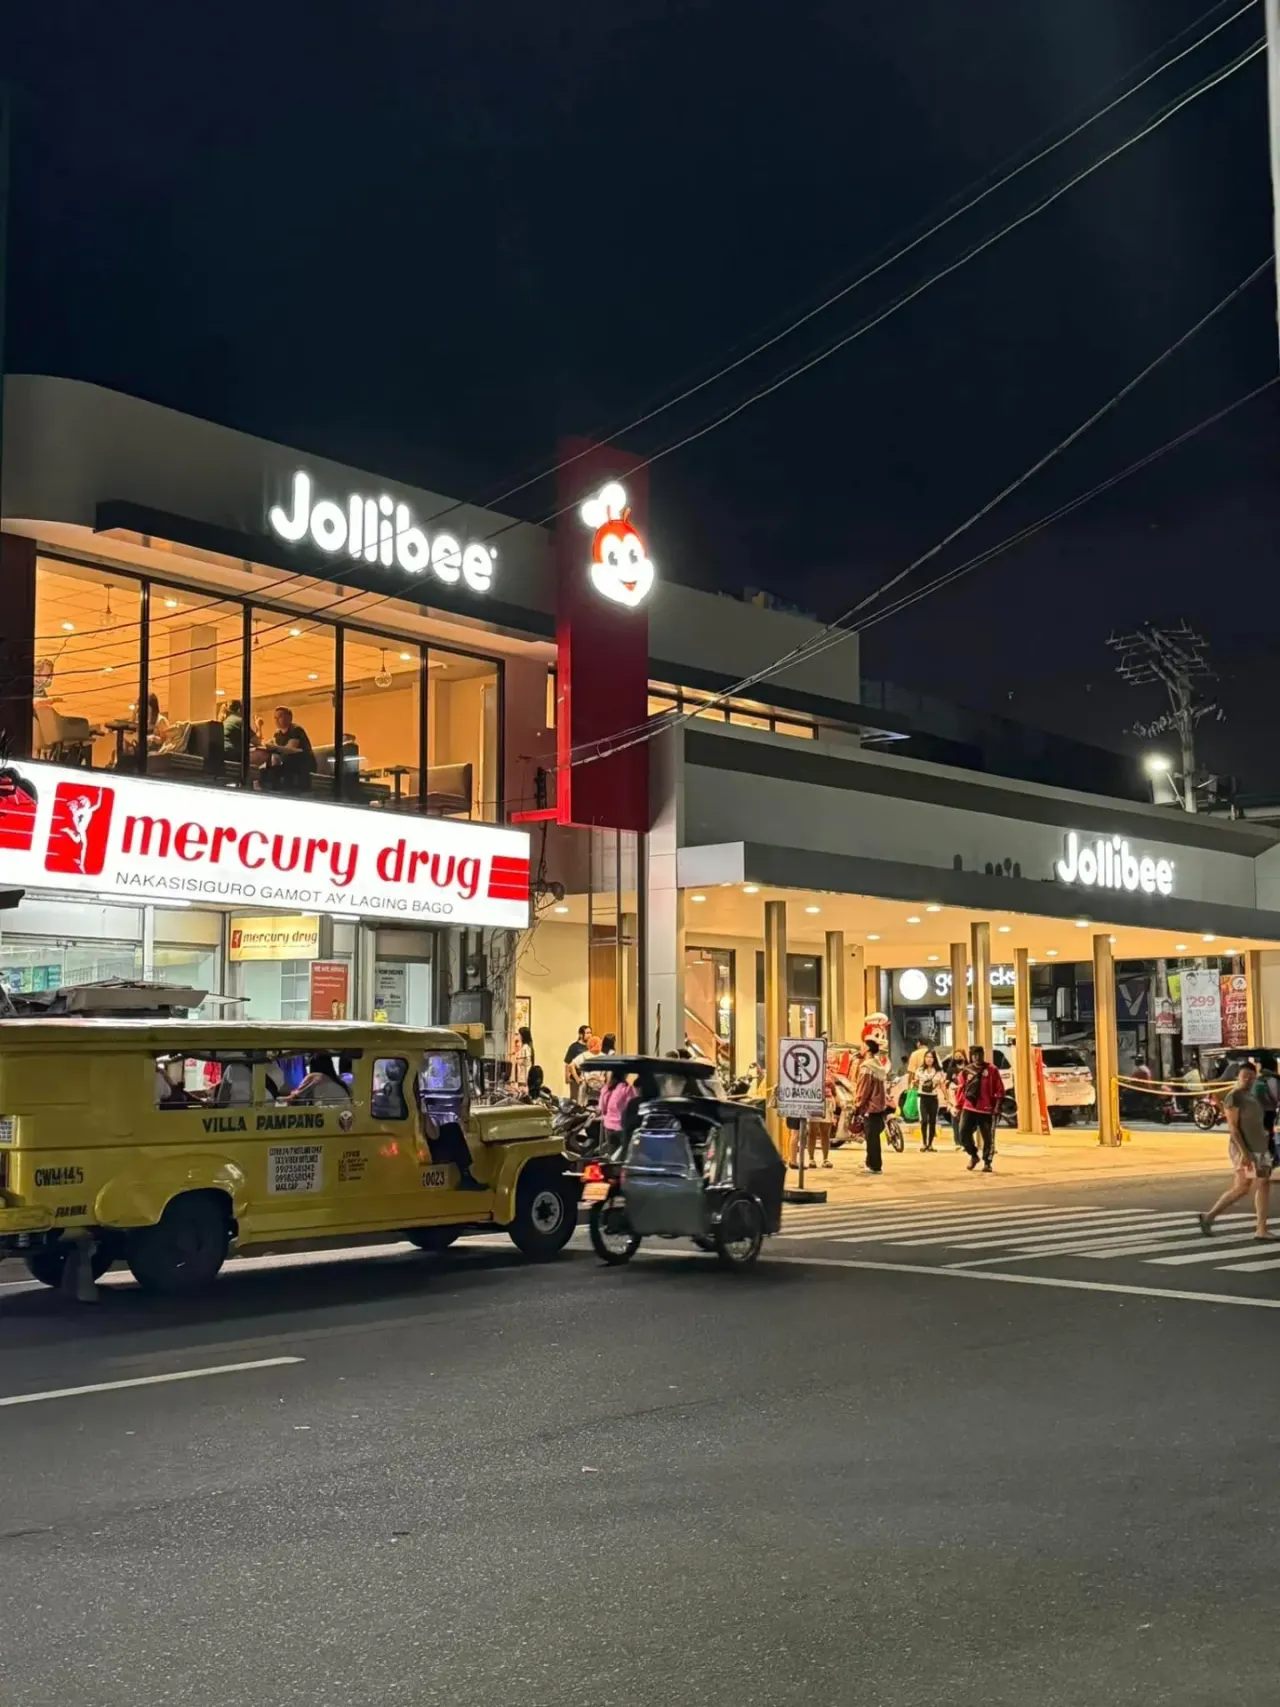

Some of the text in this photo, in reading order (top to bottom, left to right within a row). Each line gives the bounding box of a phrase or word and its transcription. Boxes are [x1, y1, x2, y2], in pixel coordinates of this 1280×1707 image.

[268, 469, 493, 592] Jollibee
[120, 815, 482, 900] mercury drug
[1056, 831, 1173, 896] Jollibee
[115, 871, 454, 915] NAKASISIGURO GAMOT AY LAGING BAGO
[242, 929, 319, 944] mercury drug
[792, 1087, 822, 1100] PARKING
[202, 1112, 325, 1133] VILLA PAMPANG
